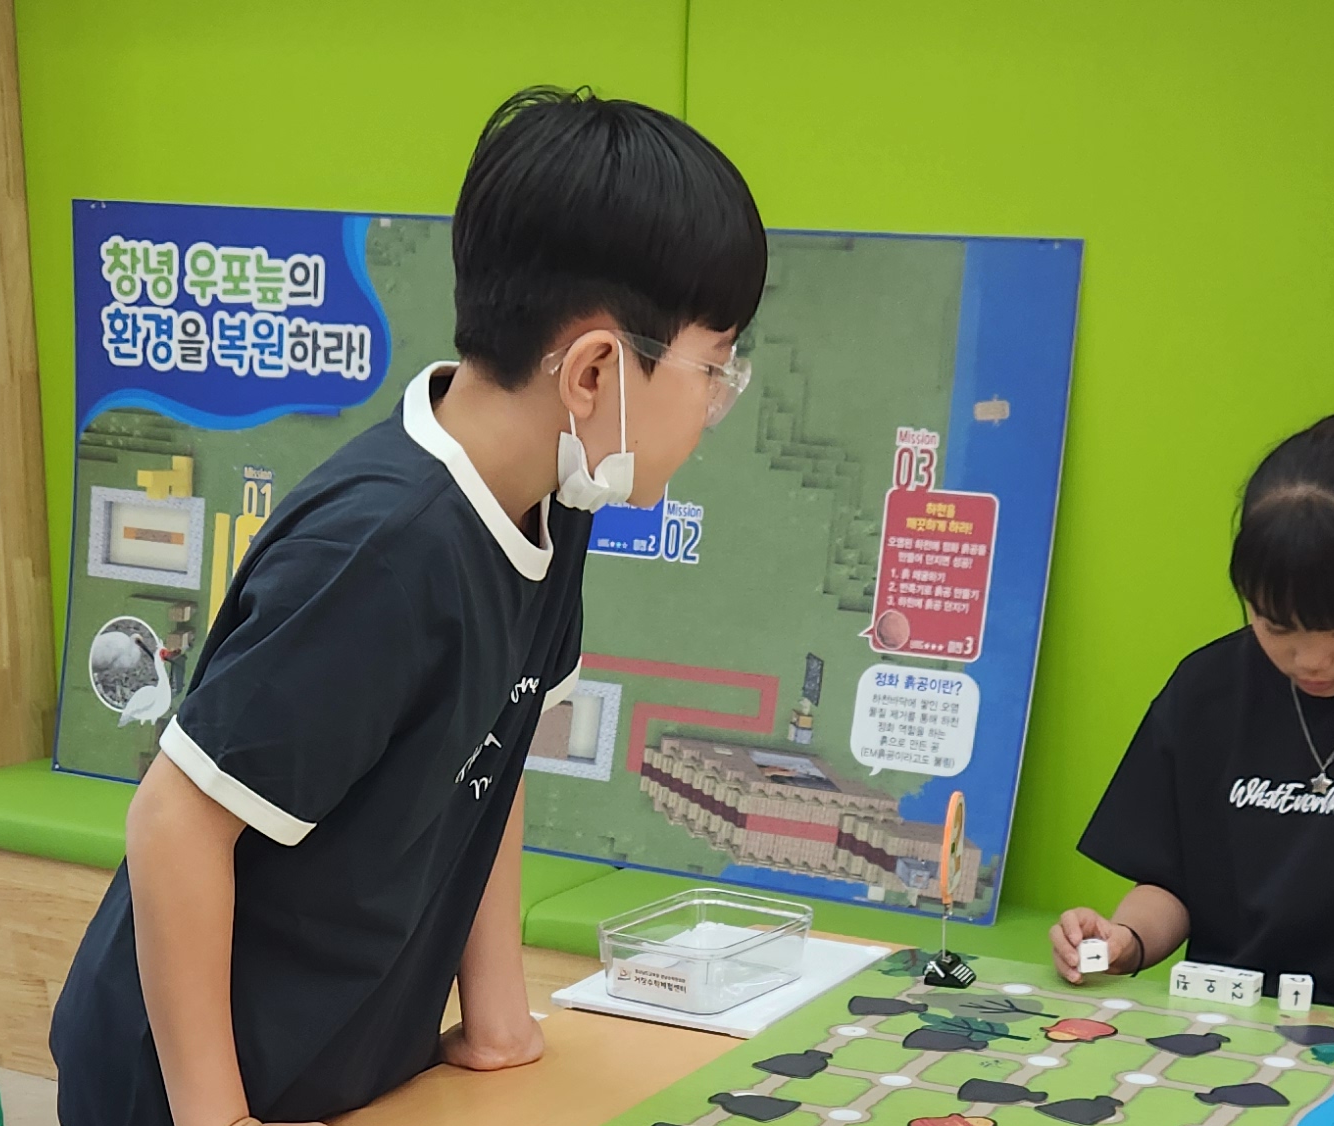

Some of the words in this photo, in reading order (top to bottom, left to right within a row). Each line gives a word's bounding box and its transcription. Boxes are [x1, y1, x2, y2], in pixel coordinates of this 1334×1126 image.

[104, 239, 175, 301] 창녕
[188, 247, 320, 305] 우포늪의
[105, 307, 207, 365] 환경을
[217, 316, 367, 374] 복원하라!
[898, 429, 937, 445] Mission
[895, 446, 934, 488] 03
[243, 480, 272, 518] 01
[667, 502, 702, 519] Mission
[647, 534, 656, 552] 2
[664, 518, 701, 562] 02
[963, 636, 974, 655] 3
[875, 672, 899, 688] 정화
[904, 675, 963, 696] 흙공이란?
